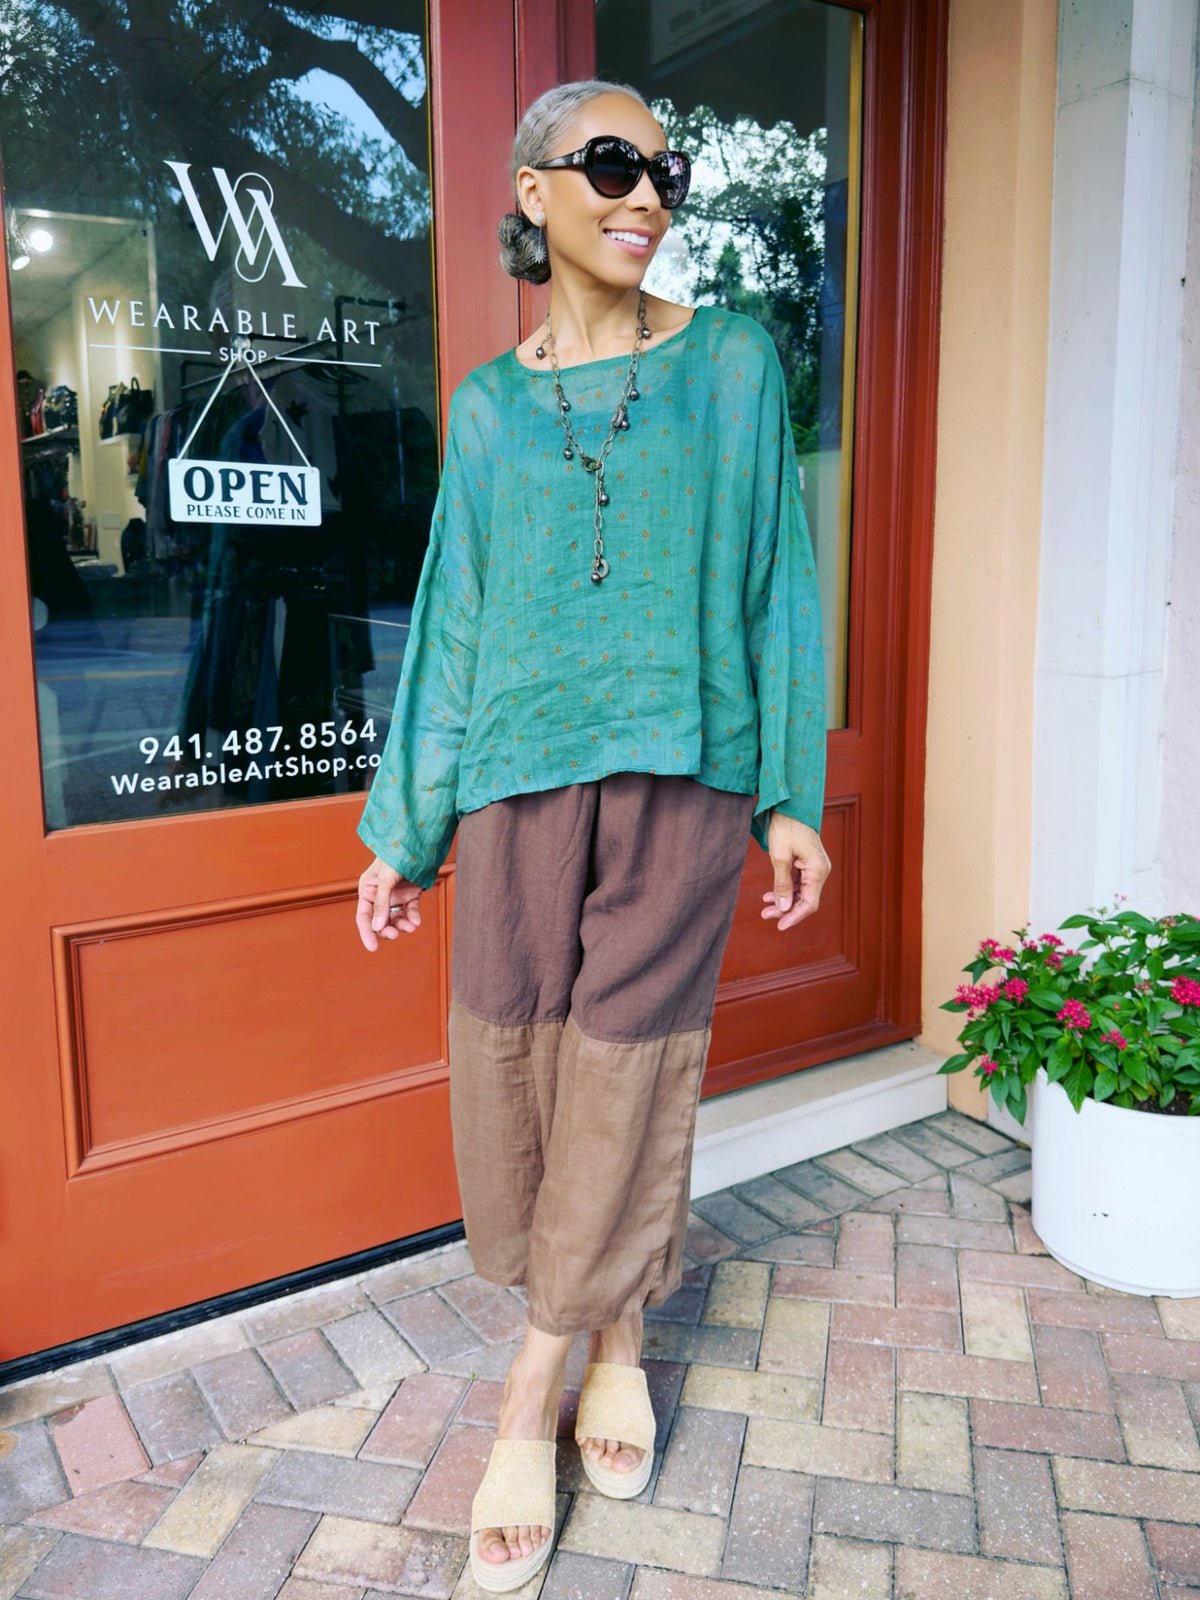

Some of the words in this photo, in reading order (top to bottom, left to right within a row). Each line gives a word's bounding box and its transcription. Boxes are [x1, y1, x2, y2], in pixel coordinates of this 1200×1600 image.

[88, 297, 297, 339] WEARABLE
[317, 317, 380, 345] ART
[219, 347, 267, 363] SHOP
[183, 466, 308, 505] OPEN
[187, 504, 241, 518] PLEASE
[246, 507, 285, 519] COME
[291, 508, 306, 521] IN
